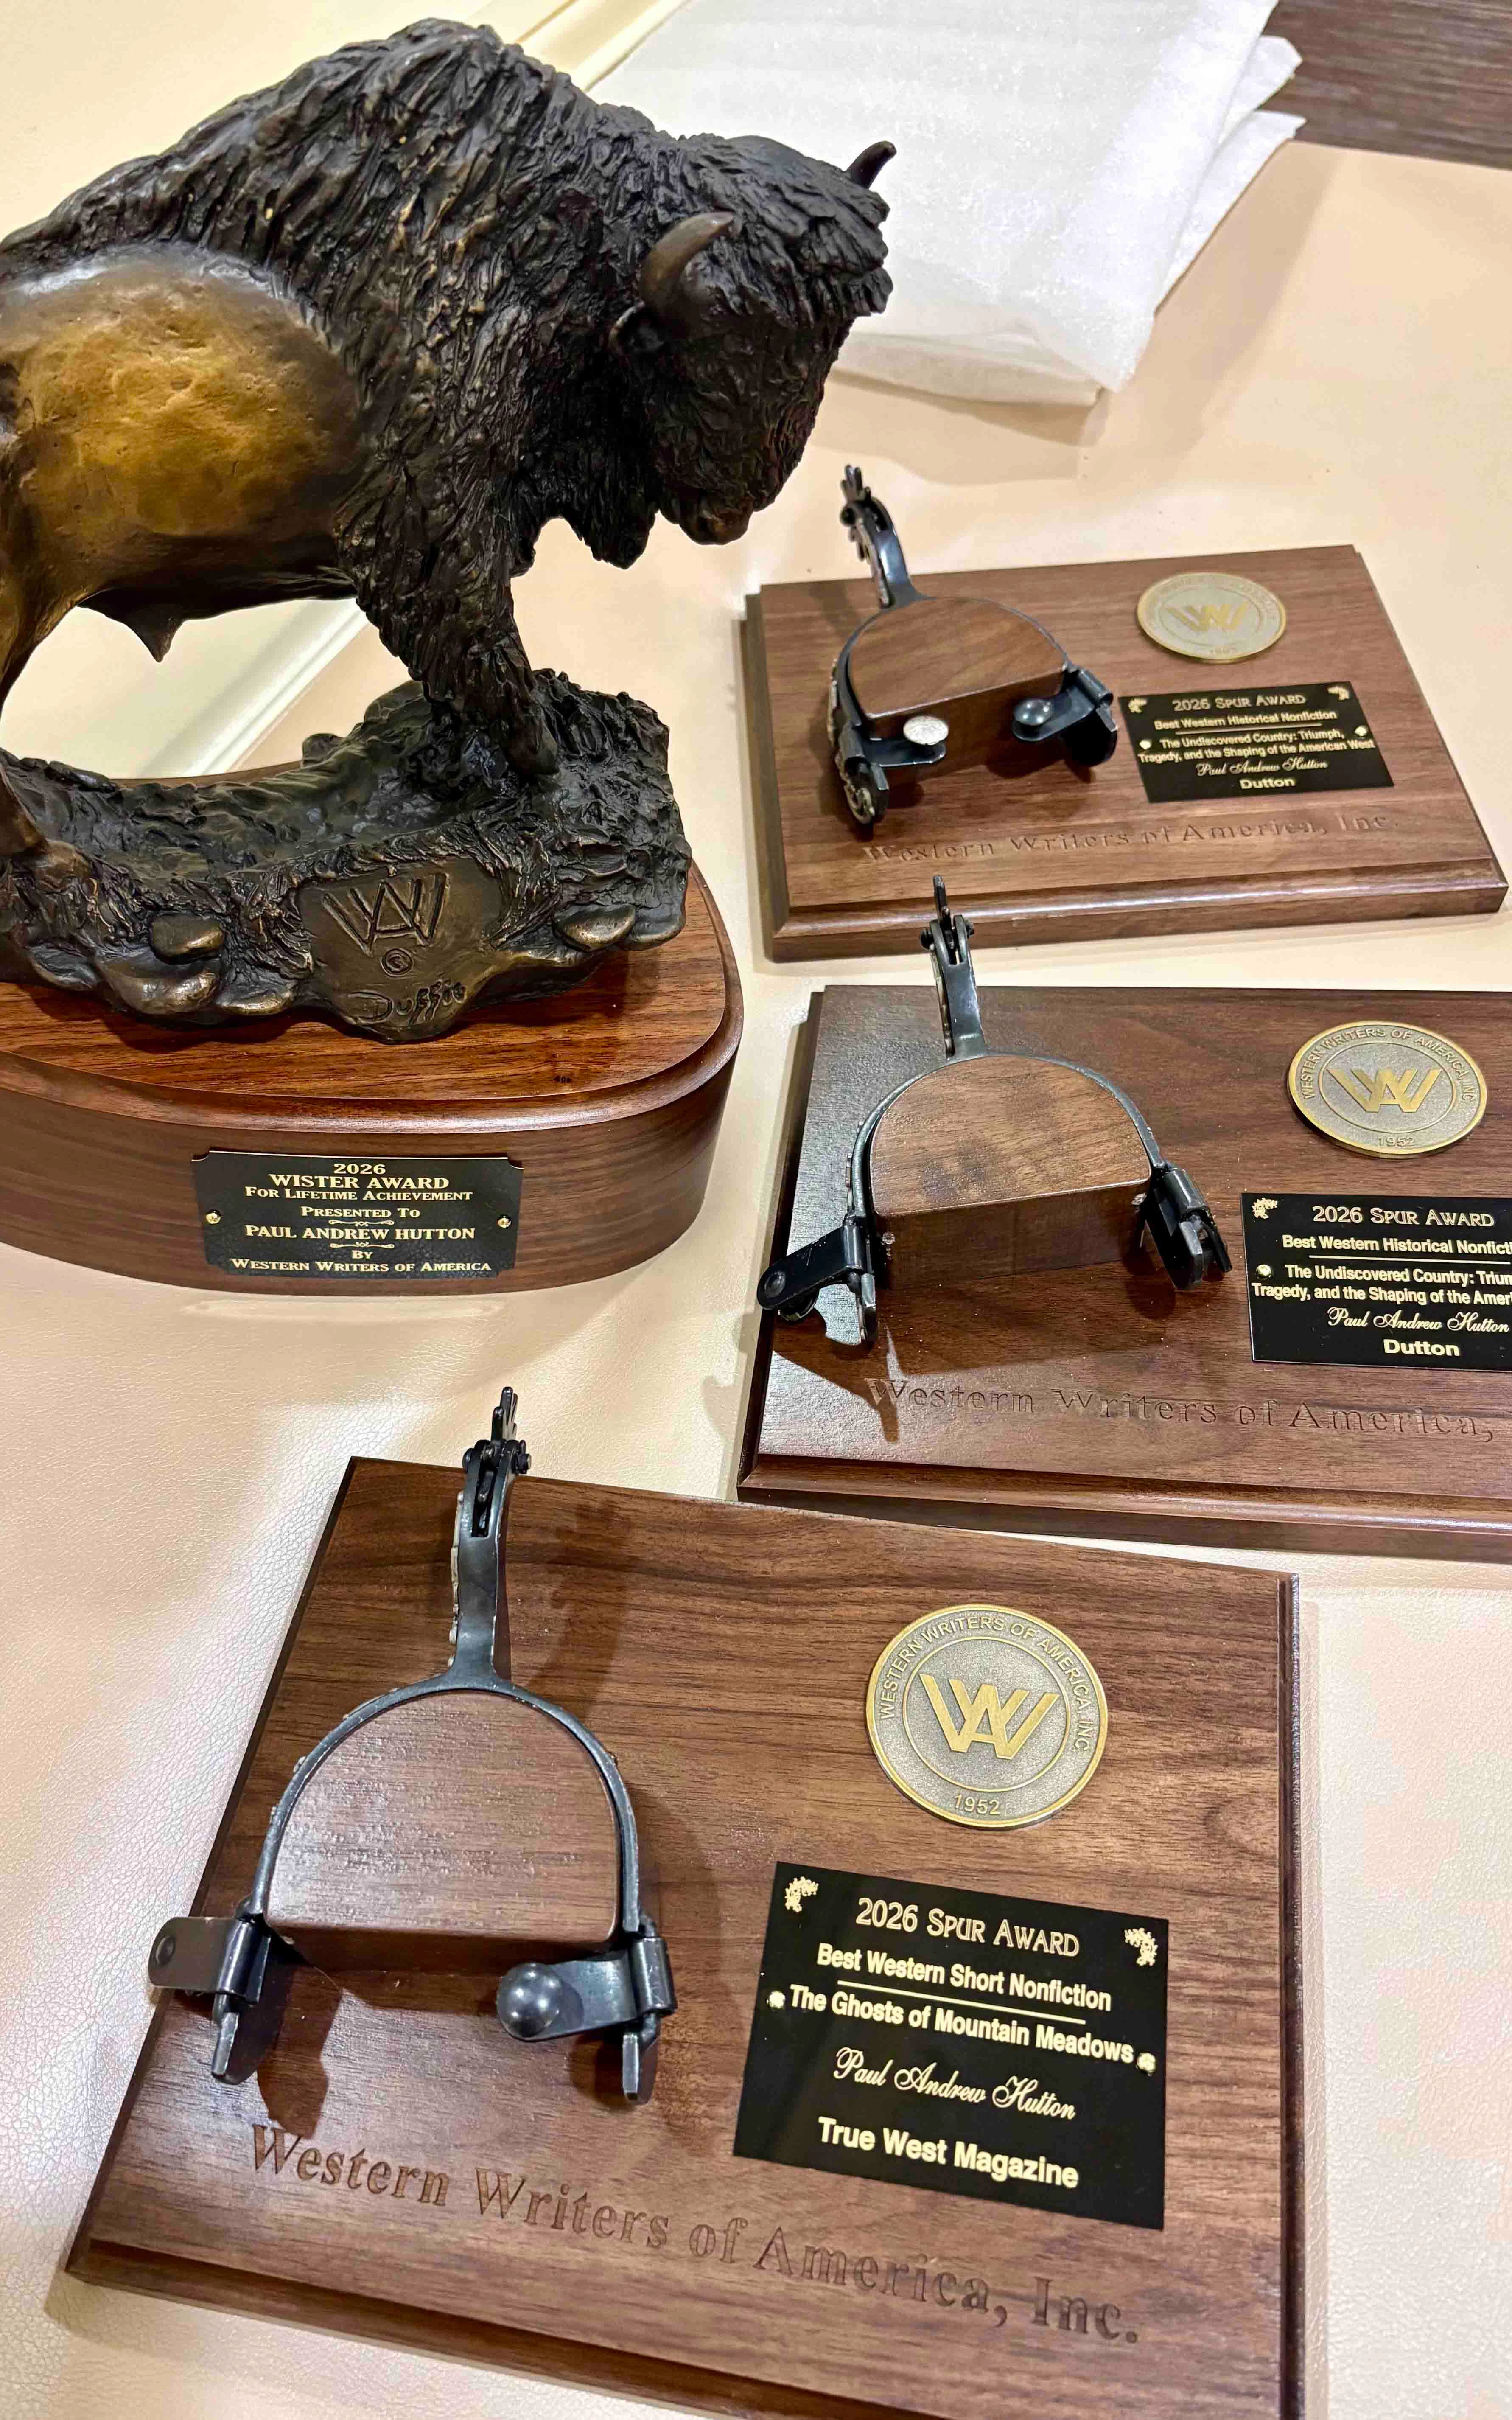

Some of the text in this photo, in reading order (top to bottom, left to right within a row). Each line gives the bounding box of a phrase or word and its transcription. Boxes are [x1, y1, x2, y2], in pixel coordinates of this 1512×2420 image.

[1172, 699, 1211, 712] 2026
[1154, 711, 1337, 730] Best Western Historical Nonfiction
[1160, 729, 1344, 749] The Undiscovered Country: Triumph,
[1138, 739, 1375, 763] Tragedy, and the Shaping of the American West
[1195, 756, 1328, 776] Paul Andrew Hutton
[1239, 777, 1296, 789] Dutton
[862, 812, 1399, 862] Western Writers of America, Inc.
[1301, 1049, 1323, 1099] WESTERN
[1323, 1028, 1386, 1050] WRITERS
[1392, 1029, 1413, 1040] OF
[1378, 1136, 1415, 1147] 1952
[333, 1164, 386, 1175] 2026
[269, 1174, 449, 1189] WISTER AWARD
[1312, 1206, 1363, 1223] 2026
[244, 1225, 475, 1239] PAUL ANDREW HUTTON
[1282, 1234, 1317, 1248] Best
[1318, 1236, 1380, 1251] Western
[1383, 1238, 1453, 1253] Historical
[1285, 1264, 1312, 1278] The
[1314, 1265, 1410, 1282] Undiscovered
[1413, 1268, 1475, 1287] Country:
[1252, 1283, 1311, 1301] Tragedy,
[1314, 1286, 1341, 1300] and
[1343, 1286, 1366, 1300] the
[1369, 1287, 1427, 1305] Shaping
[1430, 1289, 1444, 1303] of
[1447, 1289, 1470, 1304] the
[1327, 1307, 1510, 1332] Paul Andrew Hutton
[1383, 1339, 1460, 1357] Dutton
[865, 1378, 1493, 1443] Western Writers of America,
[880, 1639, 923, 1721] WESTERN
[921, 1616, 1005, 1643] WRITERS
[1011, 1623, 1037, 1640] OF
[953, 1793, 1001, 1815] 1952
[856, 1898, 918, 1932] 2026
[817, 1942, 1112, 2011] Best Western Short Nonfiction
[790, 1984, 1134, 2064] The Ghosts of Mountain Meadows
[833, 2047, 1076, 2120] Paul Andrew Hutton
[818, 2116, 1079, 2189] True West Magazine
[252, 2123, 1139, 2344] Western Writers of America, Inc.
